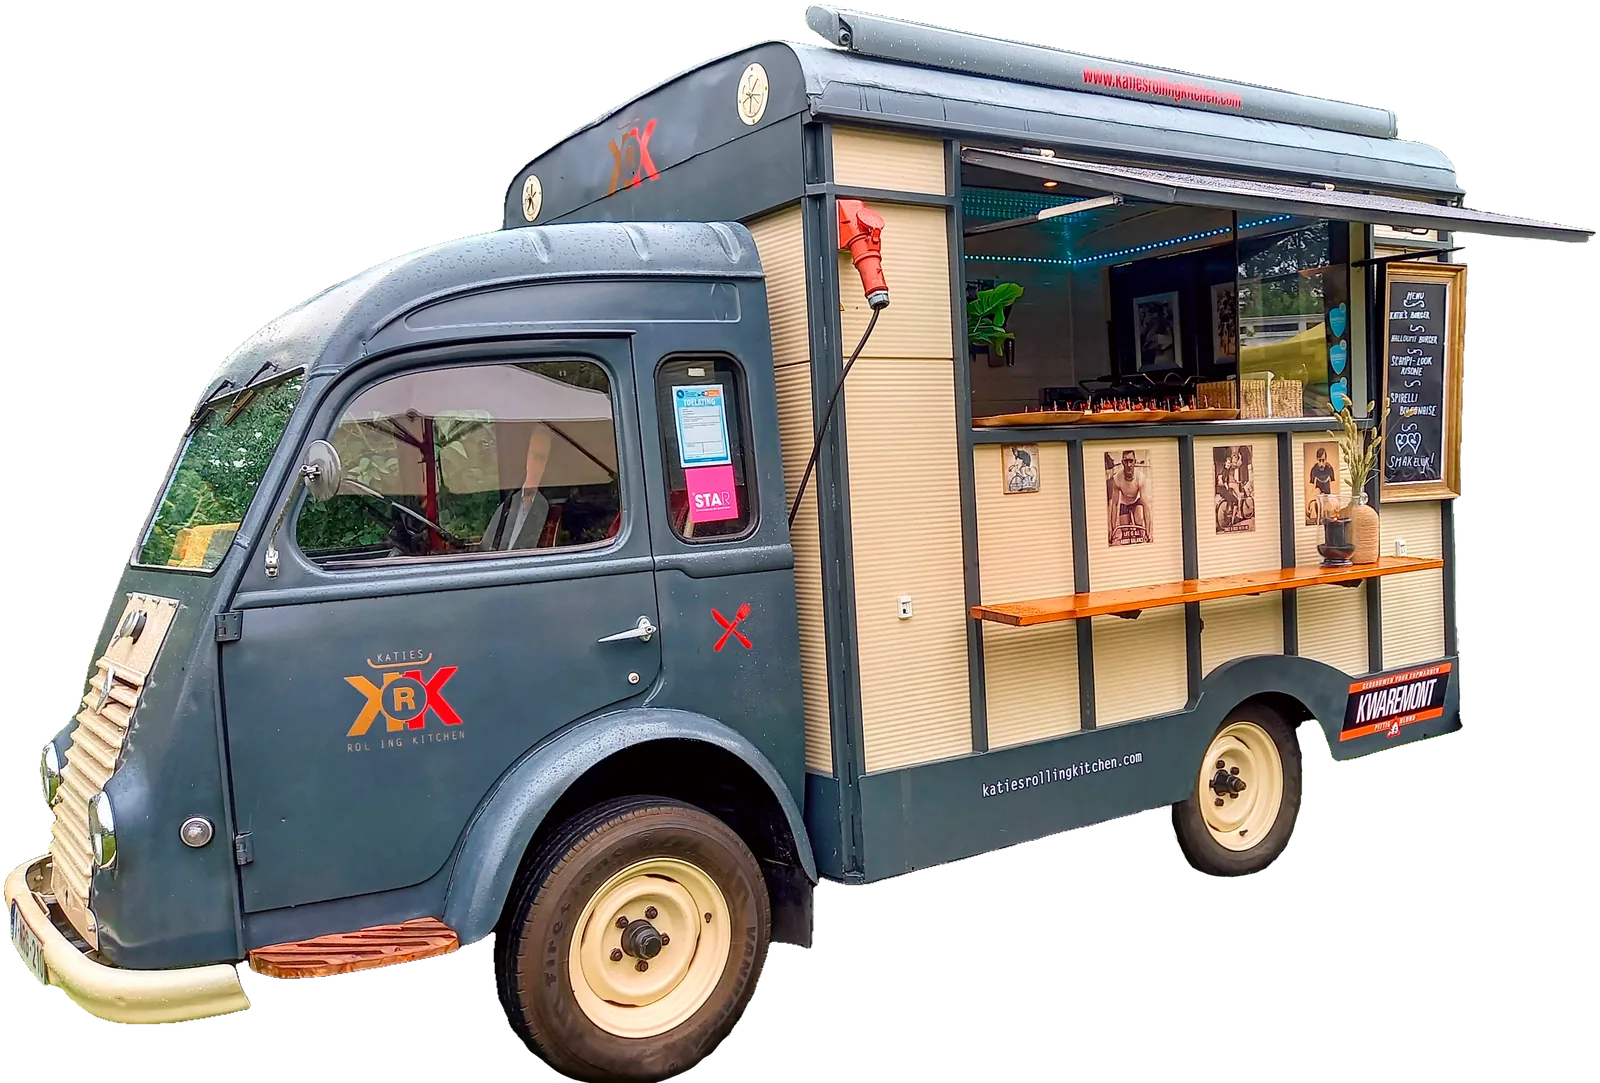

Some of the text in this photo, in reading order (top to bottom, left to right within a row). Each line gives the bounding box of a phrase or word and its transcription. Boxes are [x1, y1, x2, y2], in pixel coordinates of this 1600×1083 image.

[1406, 291, 1425, 300] MENU
[1410, 311, 1431, 320] BURGER
[1418, 335, 1438, 345] BURGER
[1400, 367, 1423, 376] RISONE
[683, 397, 716, 407] TOELATING
[1390, 392, 1419, 404] SPIRELLI
[694, 491, 731, 508] STAR
[377, 649, 424, 663] KATIES
[1355, 678, 1438, 724] KWAREMONT
[412, 730, 465, 745] KITCHEN
[981, 752, 1143, 798] katiesrollingkitchen.com
